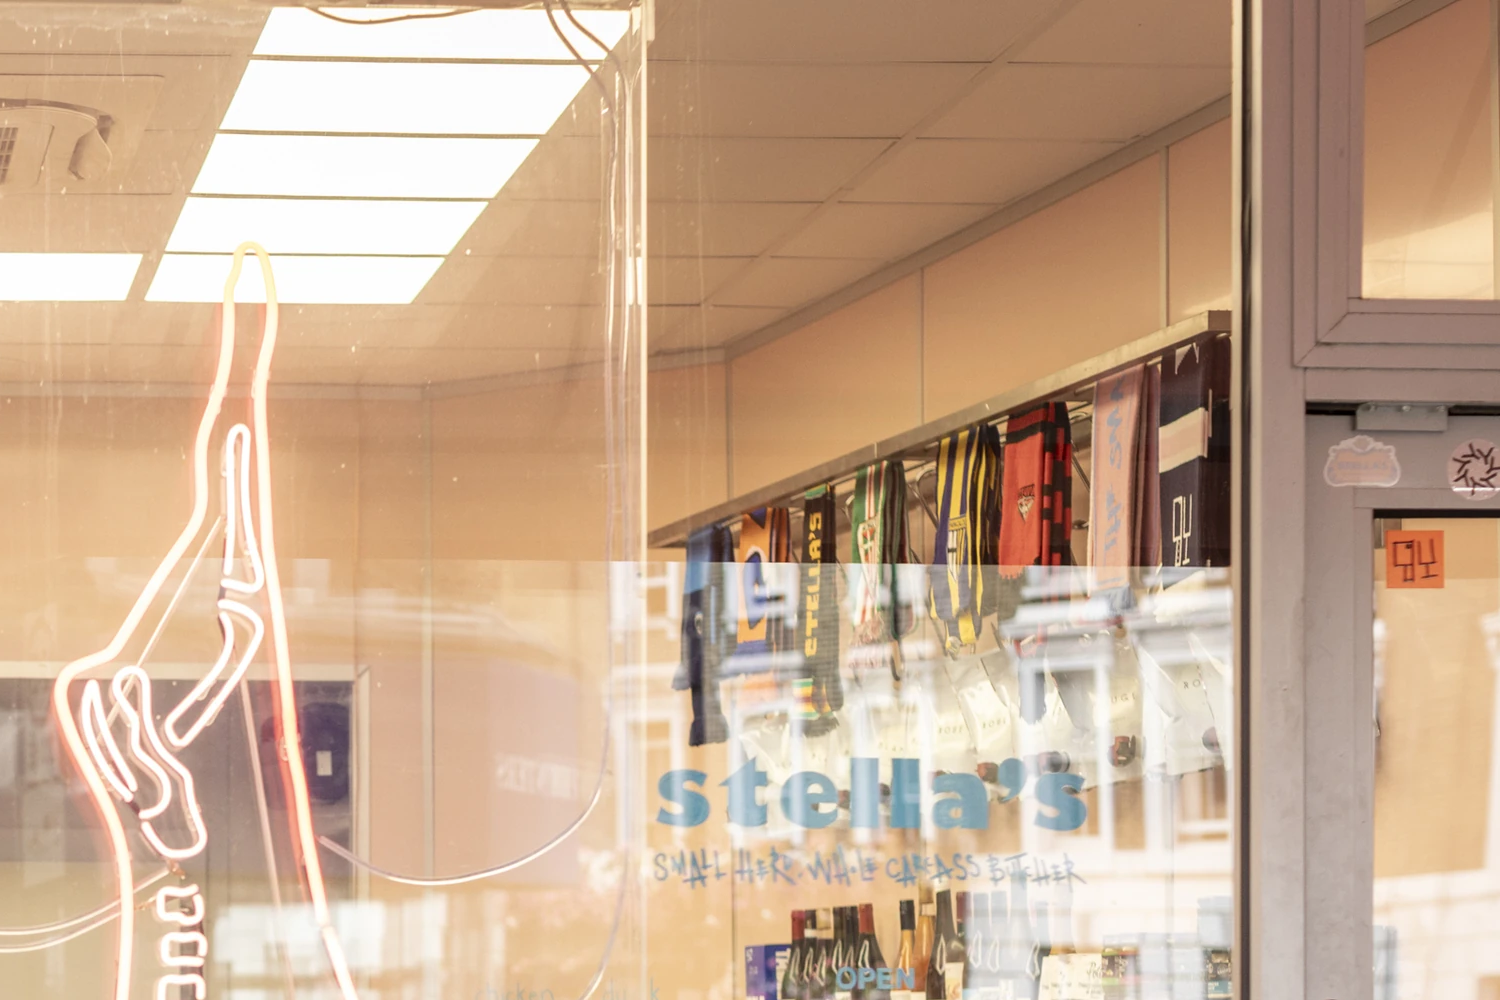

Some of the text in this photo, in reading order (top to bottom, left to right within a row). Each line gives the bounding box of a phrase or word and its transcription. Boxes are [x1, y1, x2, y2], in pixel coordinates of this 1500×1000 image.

[804, 511, 822, 658] STELLA'S
[656, 756, 1087, 831] stella's
[654, 848, 727, 889] SMALL
[986, 852, 1087, 892] BUTCHER
[836, 966, 915, 990] OPEN
